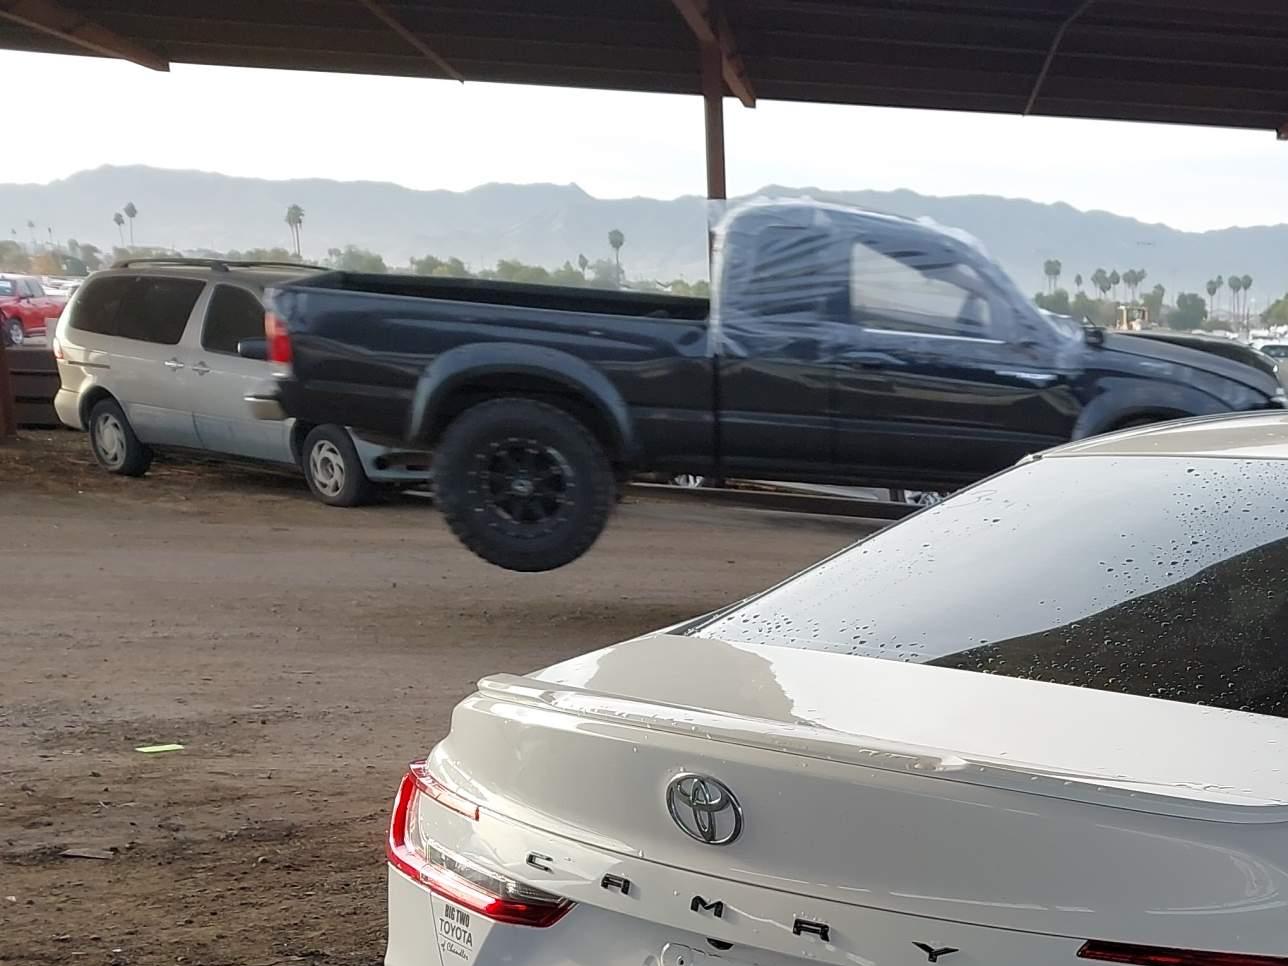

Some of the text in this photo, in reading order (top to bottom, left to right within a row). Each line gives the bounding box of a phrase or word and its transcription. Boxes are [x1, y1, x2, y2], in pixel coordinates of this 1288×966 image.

[445, 904, 470, 928] BIG TWO
[525, 851, 959, 963] CAMRY
[439, 918, 473, 946] TOYOTA
